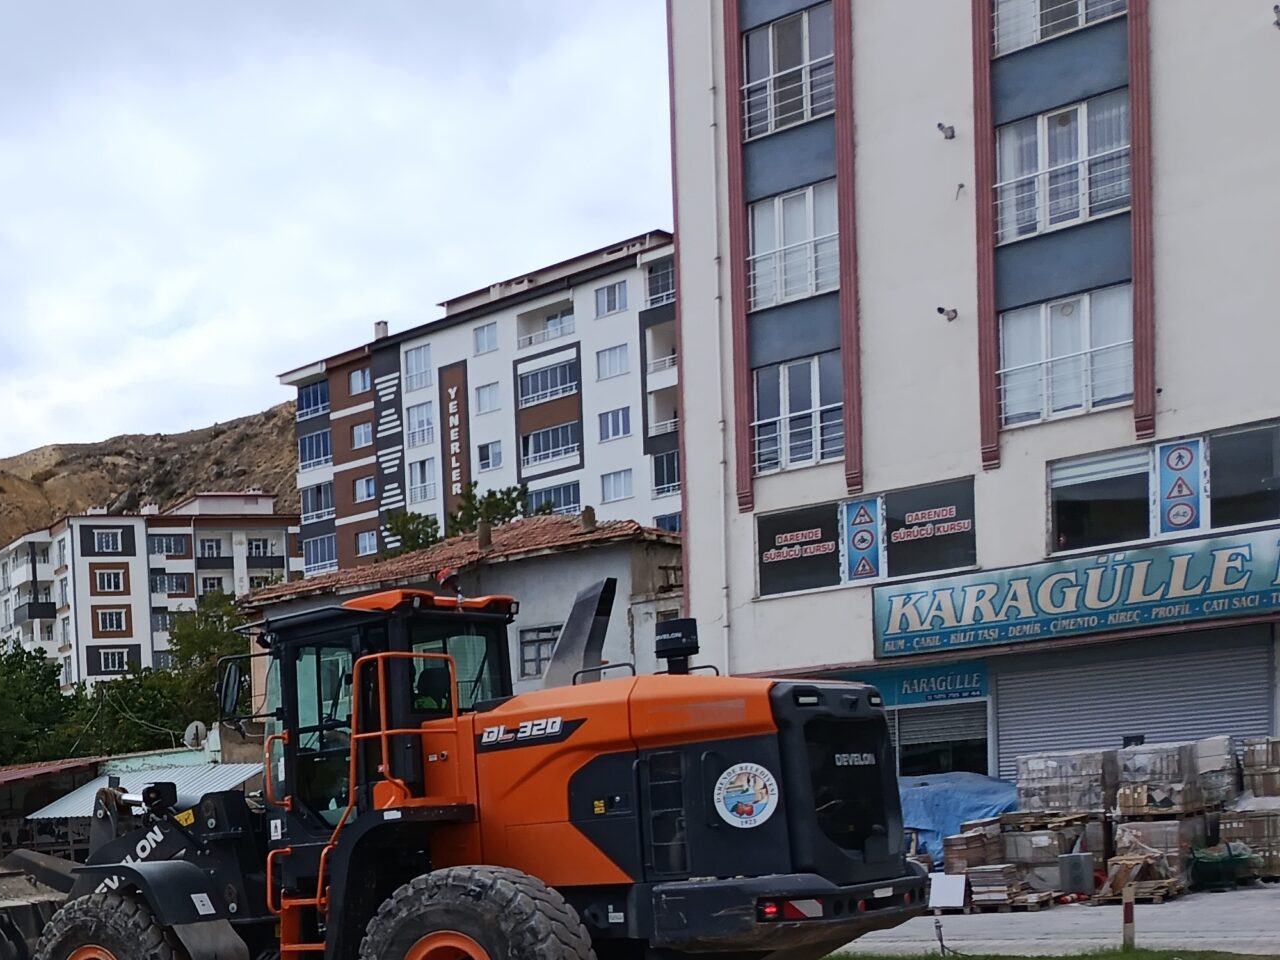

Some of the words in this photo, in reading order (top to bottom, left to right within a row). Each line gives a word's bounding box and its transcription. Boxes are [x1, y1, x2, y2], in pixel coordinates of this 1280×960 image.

[448, 386, 462, 496] YENERLER
[905, 506, 956, 524] DARENDE
[775, 528, 822, 546] DARENDE
[935, 519, 971, 536] KURSU
[801, 541, 836, 556] KURSU
[884, 543, 1253, 635] KARAGÜLLE
[884, 638, 905, 652] KUM
[913, 635, 942, 651] ÇAKIL
[950, 629, 975, 644] KİLİT
[977, 627, 999, 643] TAŞI
[1008, 621, 1041, 637] DEMİR
[1050, 615, 1098, 633] ÇİMENTO
[1107, 609, 1141, 625] KİREÇ
[1151, 602, 1192, 619] PROFİL
[1203, 598, 1229, 615] ÇATI
[1232, 594, 1260, 608] SACI
[902, 672, 982, 694] KARAGÜLLE
[481, 724, 515, 745] DL
[516, 716, 562, 741] 320
[835, 752, 876, 767] DEVELON
